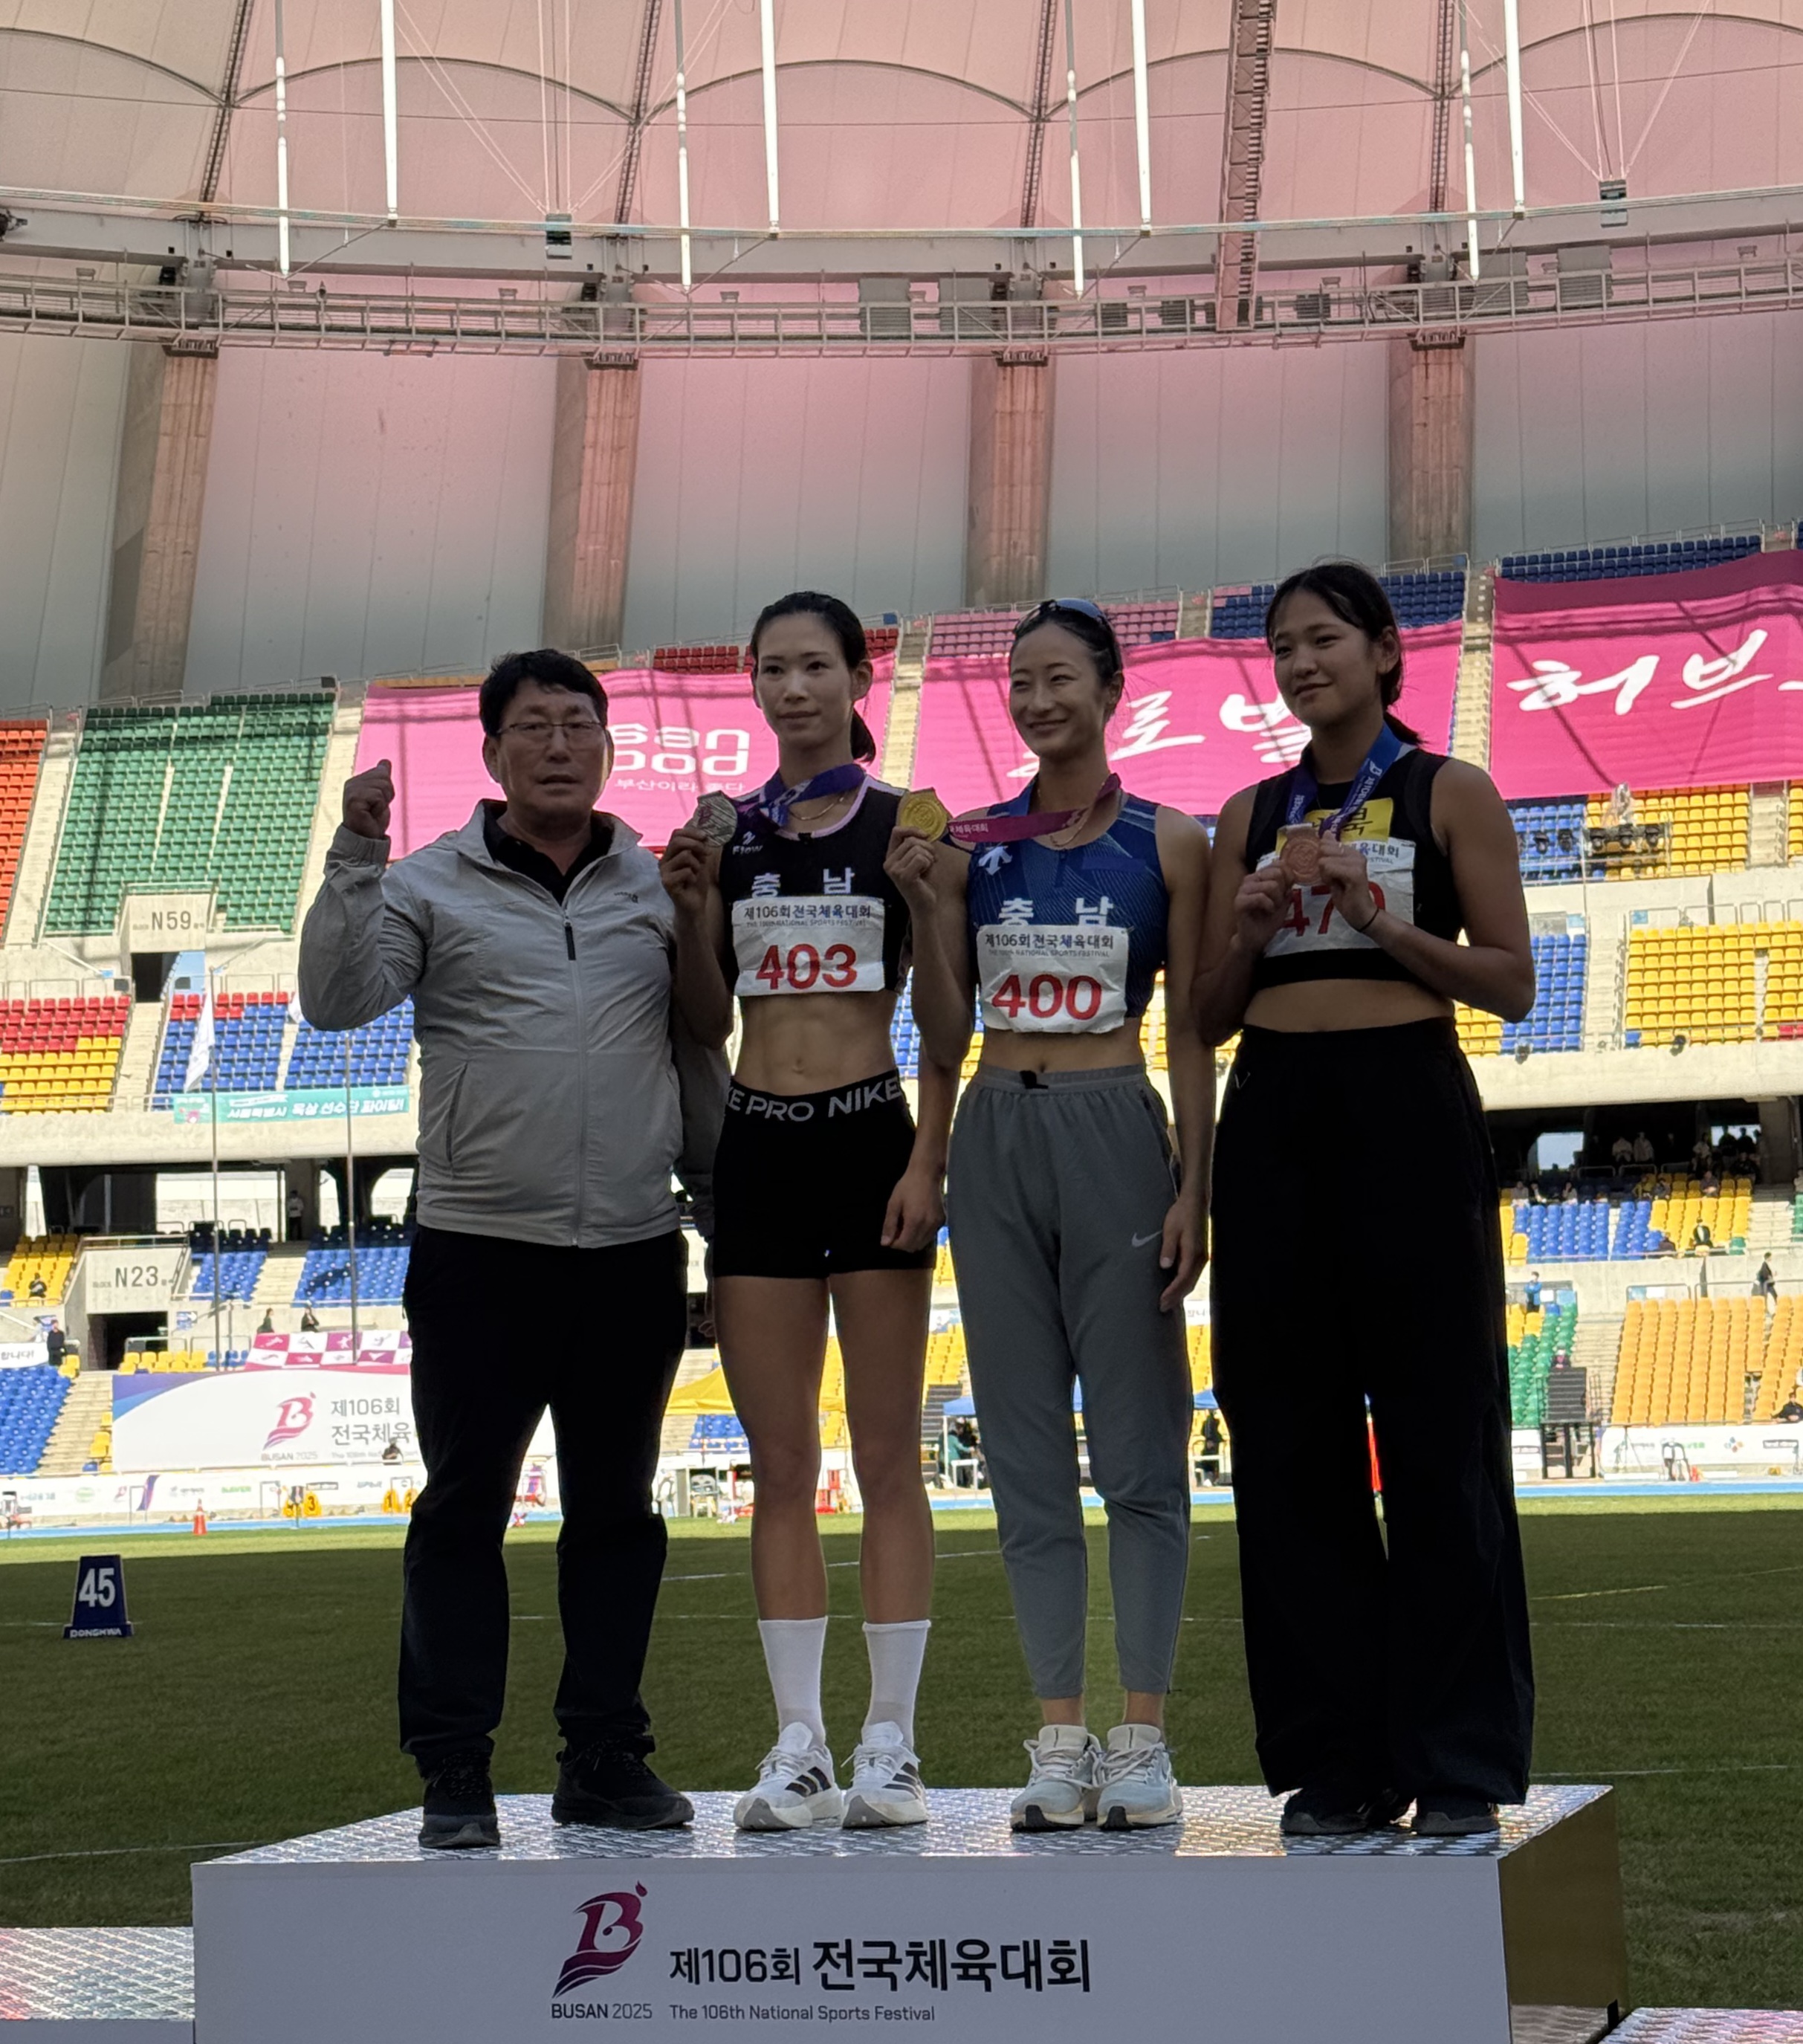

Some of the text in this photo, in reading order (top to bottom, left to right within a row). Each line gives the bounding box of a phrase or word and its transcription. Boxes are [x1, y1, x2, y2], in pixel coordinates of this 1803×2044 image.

[1506, 629, 1803, 716] 허브
[608, 723, 750, 750] san
[614, 749, 749, 776] ood
[615, 778, 698, 792] 부산이라
[152, 911, 191, 931] N59
[756, 943, 858, 990] 403
[991, 974, 1102, 1021] 400
[745, 1095, 815, 1122] PRO
[828, 1078, 902, 1118] NIKE
[115, 1266, 158, 1287] N23
[330, 1397, 400, 1417] 제106회
[331, 1422, 412, 1446] 전국체육
[308, 1495, 316, 1512] 3
[78, 1568, 116, 1608] 45
[670, 1938, 1092, 1993] 제106회 전국체육대회
[551, 2004, 653, 2019] BUSAN 2025
[670, 2005, 935, 2023] The 106th National Sports Festival
